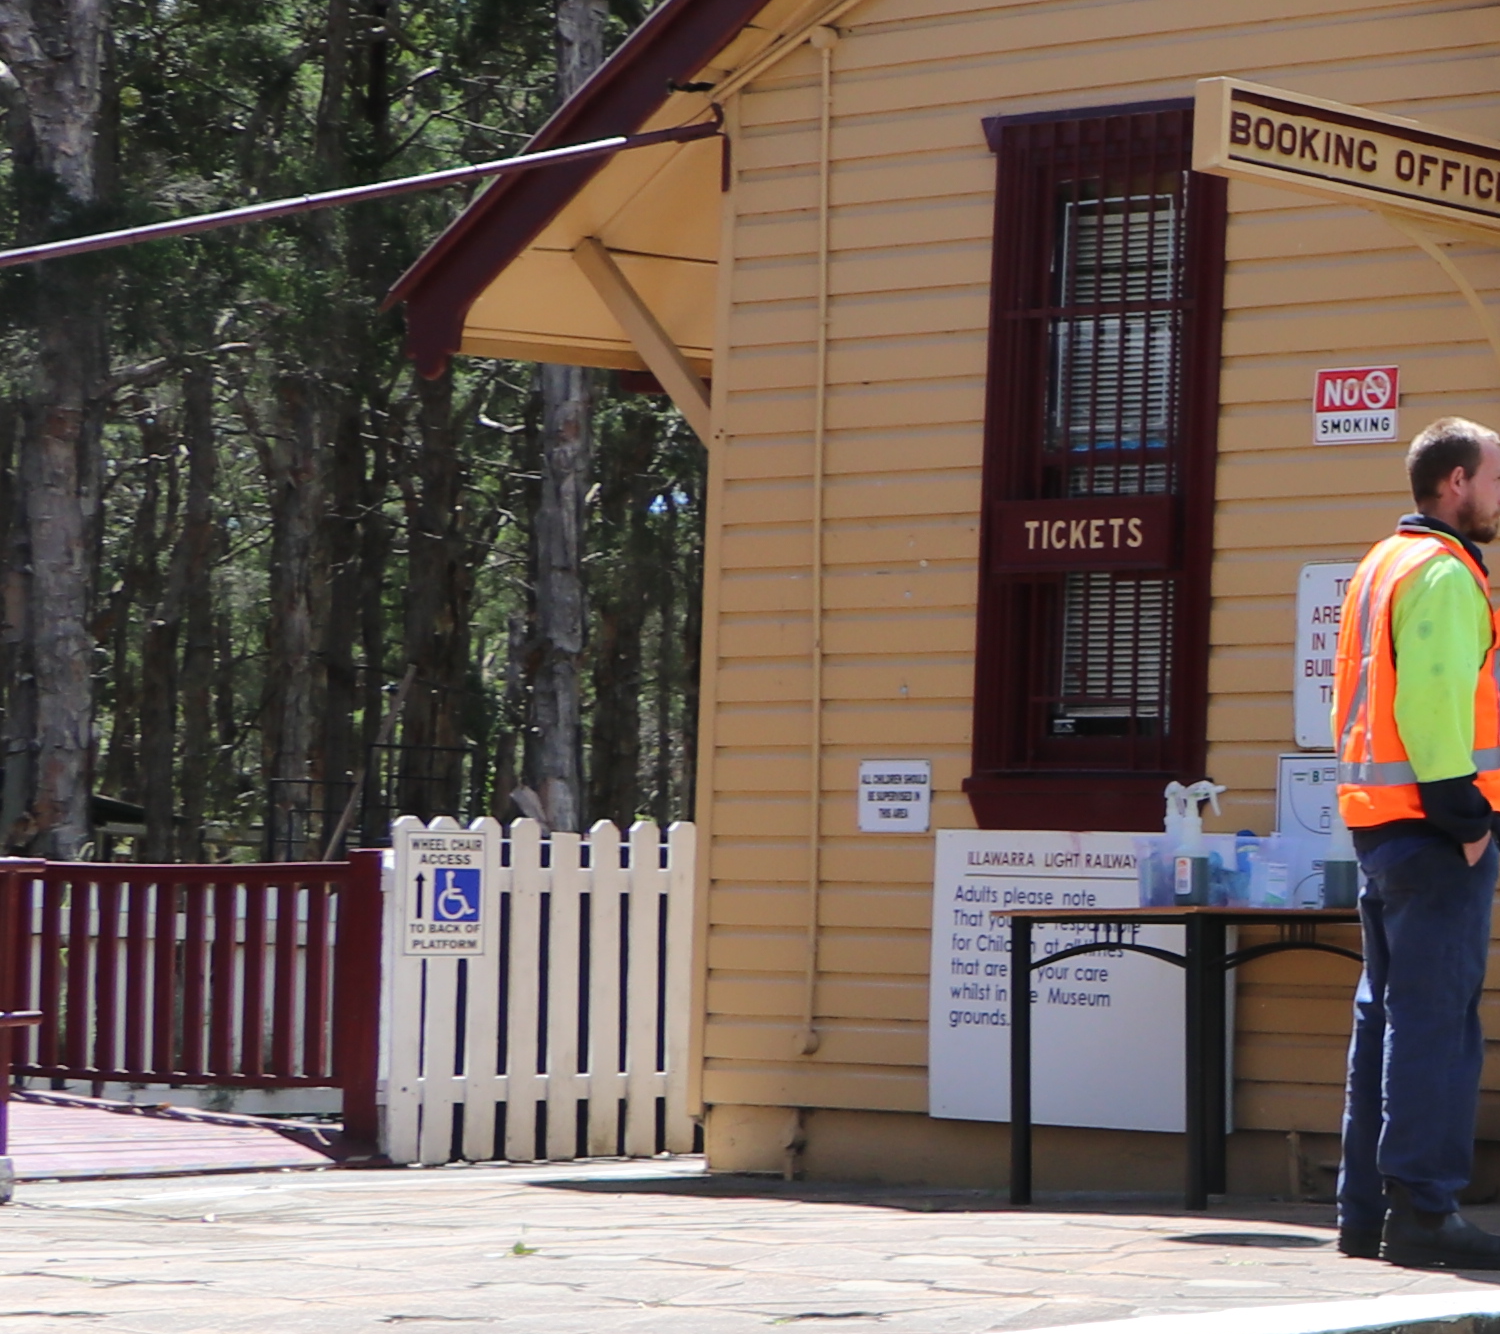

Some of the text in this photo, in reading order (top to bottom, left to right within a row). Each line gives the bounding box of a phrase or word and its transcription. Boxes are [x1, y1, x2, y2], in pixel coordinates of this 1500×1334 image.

[1230, 110, 1378, 172] BOOKING
[1323, 378, 1360, 407] NO
[1321, 416, 1390, 434] SMOKING
[1024, 517, 1143, 550] TICKETS
[1312, 632, 1326, 651] IN
[411, 838, 482, 851] WHEEL CHAIR
[420, 854, 471, 865] ACCESS
[967, 851, 1138, 869] ILLAWARRA LIGHT RAILWAY
[954, 885, 1096, 907] Adults please note
[953, 909, 984, 928] That
[410, 924, 480, 933] TO BACK OF
[412, 939, 477, 949] PLATFORM
[952, 933, 971, 951] for
[1044, 938, 1059, 955] at
[951, 958, 1108, 984] that are your care
[950, 983, 990, 1002] whilst
[995, 986, 1008, 1003] in
[1047, 988, 1112, 1008] Museum
